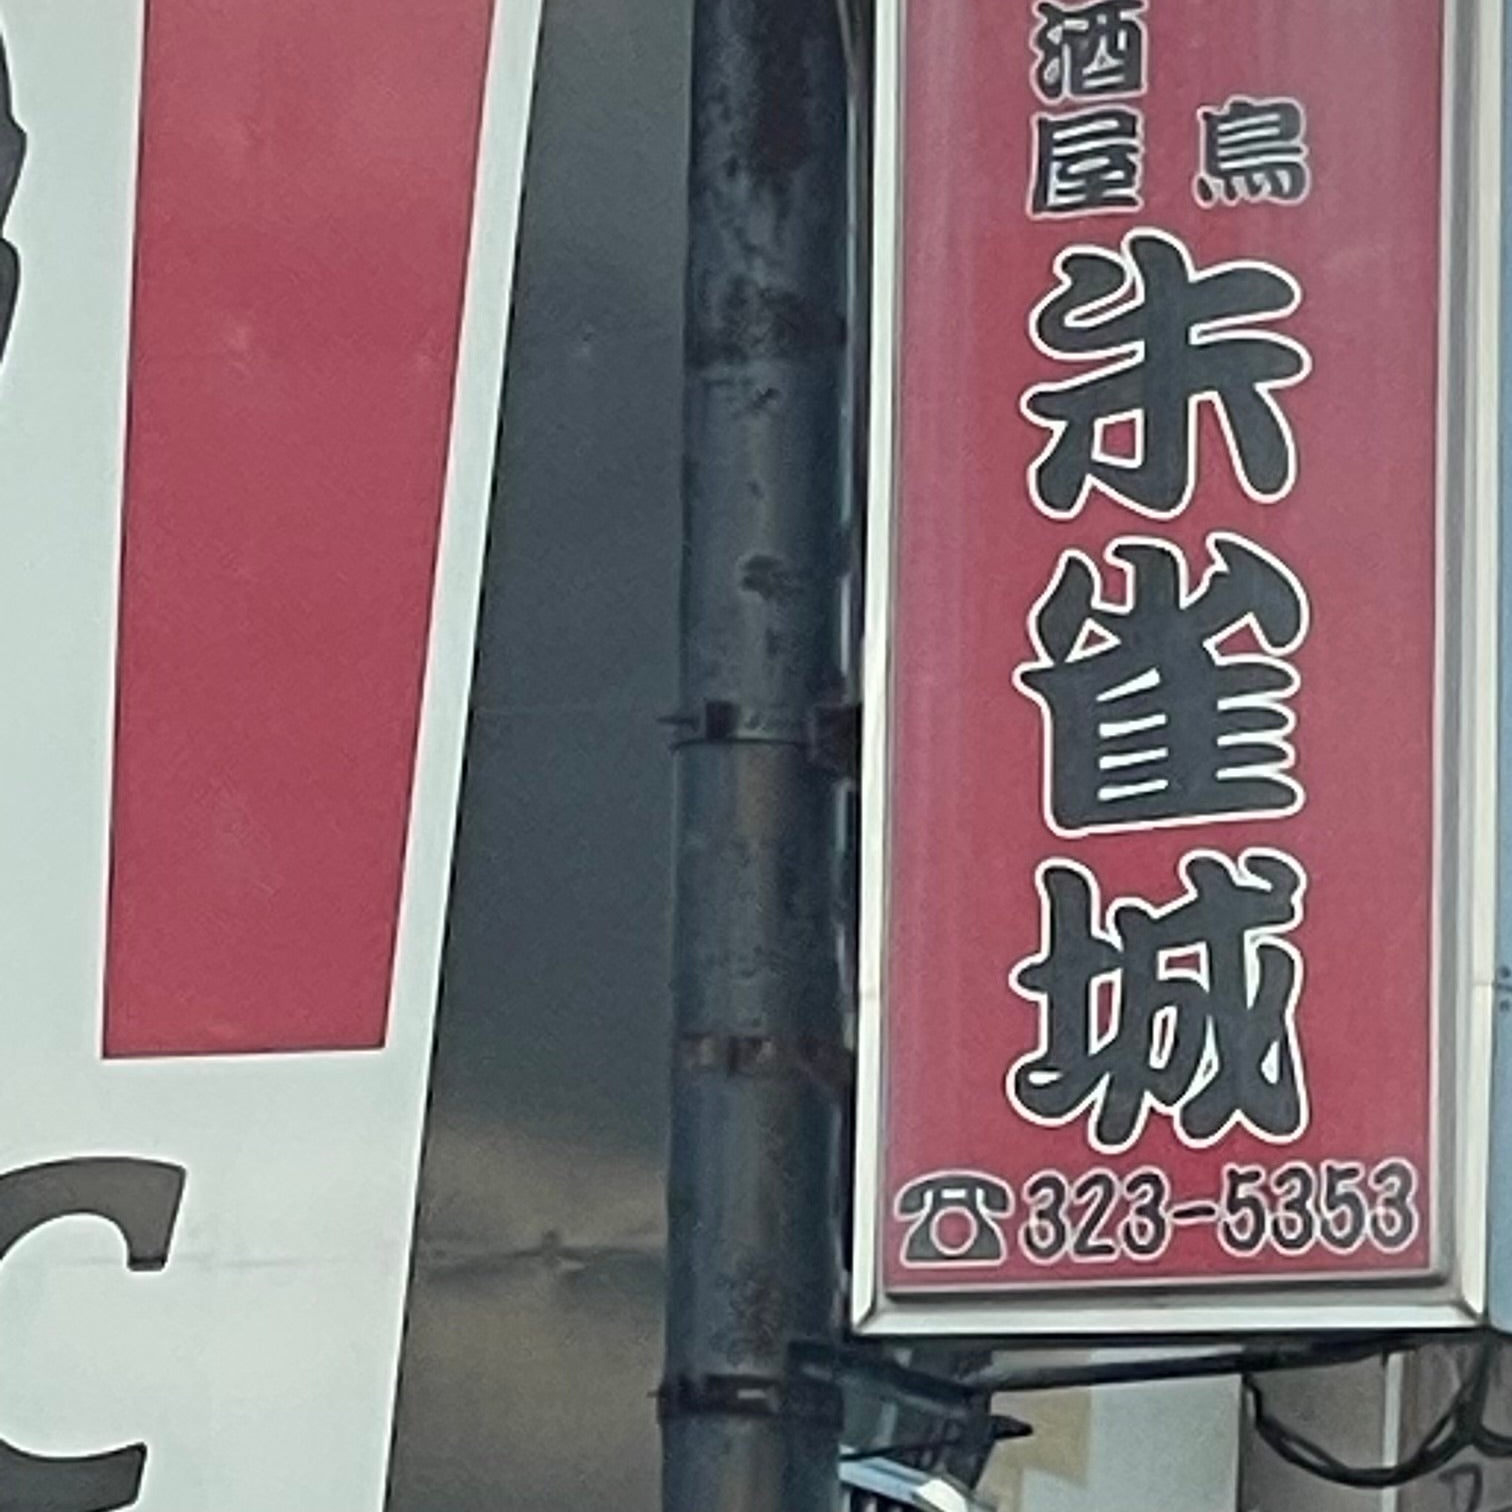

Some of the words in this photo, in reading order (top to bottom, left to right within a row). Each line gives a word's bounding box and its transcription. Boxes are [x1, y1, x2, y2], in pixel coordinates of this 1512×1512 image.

[1007, 227, 1312, 1153] 朱雀城
[1019, 1158, 1420, 1265] 323-5353
